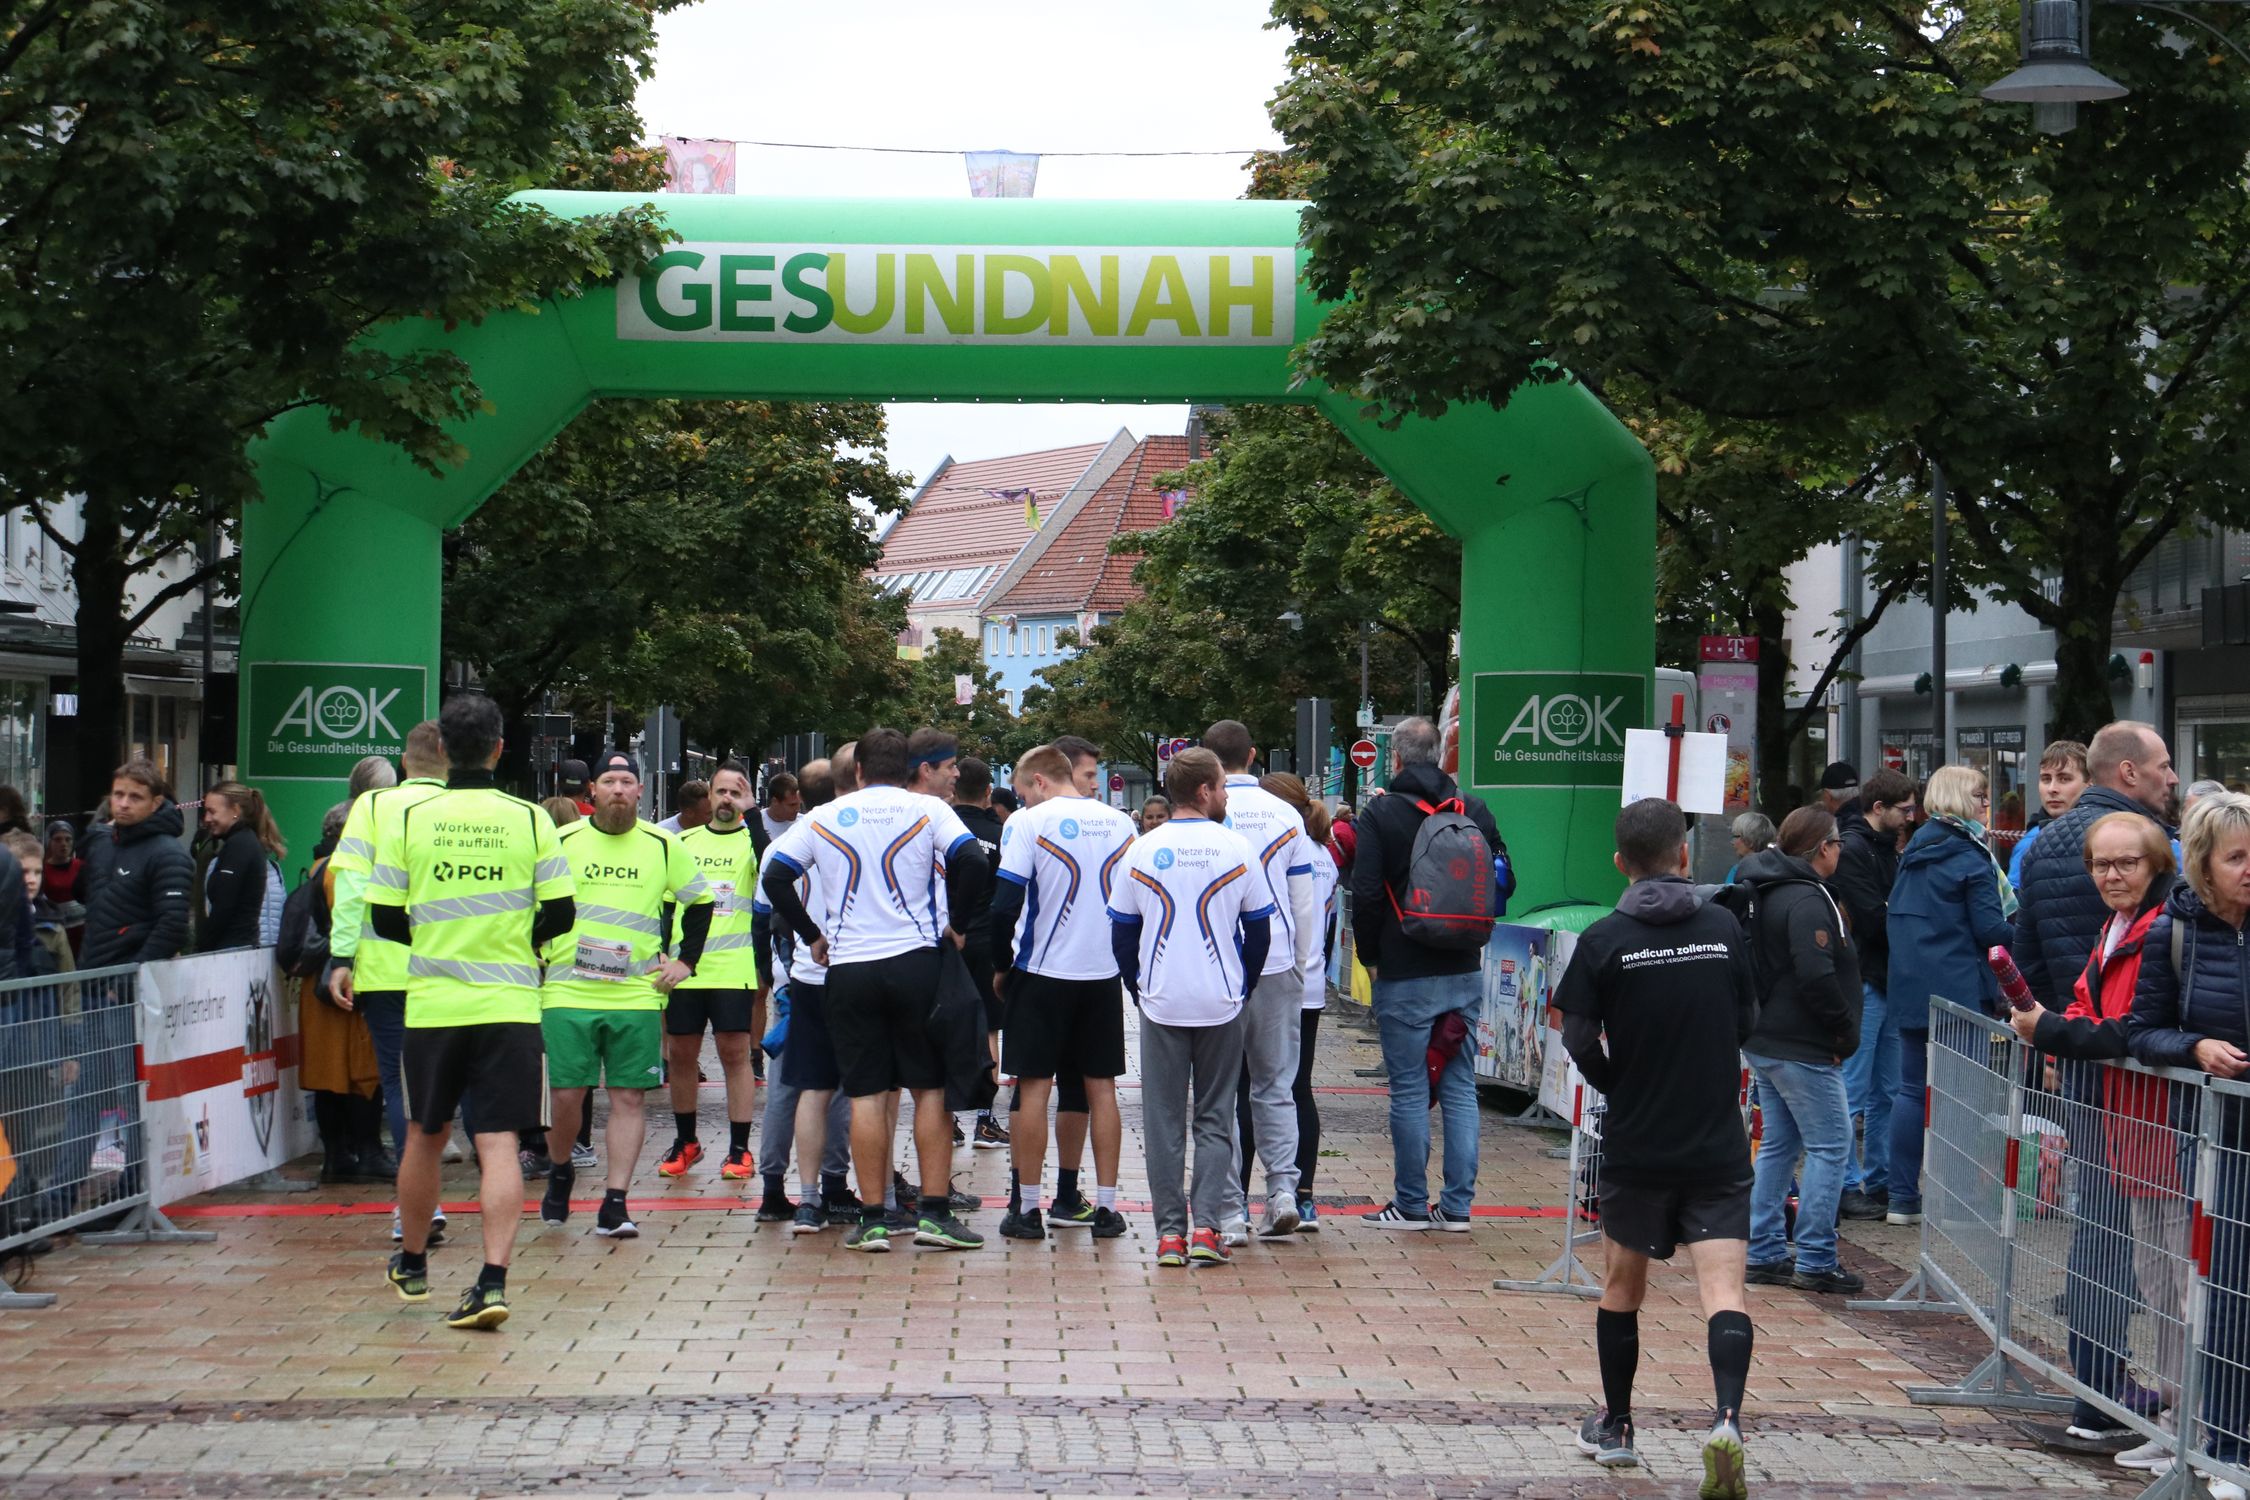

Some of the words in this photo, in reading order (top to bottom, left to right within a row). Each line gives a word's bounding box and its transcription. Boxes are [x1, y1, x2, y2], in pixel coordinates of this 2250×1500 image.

[638, 249, 1275, 338] GESUNDNAH
[271, 685, 402, 740] AOK
[1497, 693, 1625, 747] AOK
[267, 740, 285, 753] Die
[1494, 749, 1512, 762] Die
[862, 806, 888, 815] Netze
[1234, 811, 1260, 820] Netze
[1261, 811, 1276, 820] BW
[861, 816, 894, 826] bewegt
[1080, 818, 1100, 828] Netze
[1100, 819, 1118, 828] BW
[1235, 821, 1268, 831] bewegt
[433, 821, 511, 837] Workwear,
[1081, 828, 1113, 838] bewegt
[433, 836, 454, 848] die
[457, 836, 509, 850] auffällt.
[1177, 847, 1203, 857] Netze
[1205, 848, 1221, 857] BW
[703, 857, 733, 868] PCH
[1177, 858, 1210, 869] bewegt
[457, 864, 504, 881] PCH
[603, 866, 639, 880] PCH
[1621, 946, 1675, 963] medicum
[1676, 942, 1729, 956] zollernalb
[1622, 958, 1665, 970] MEDIZINISCHES
